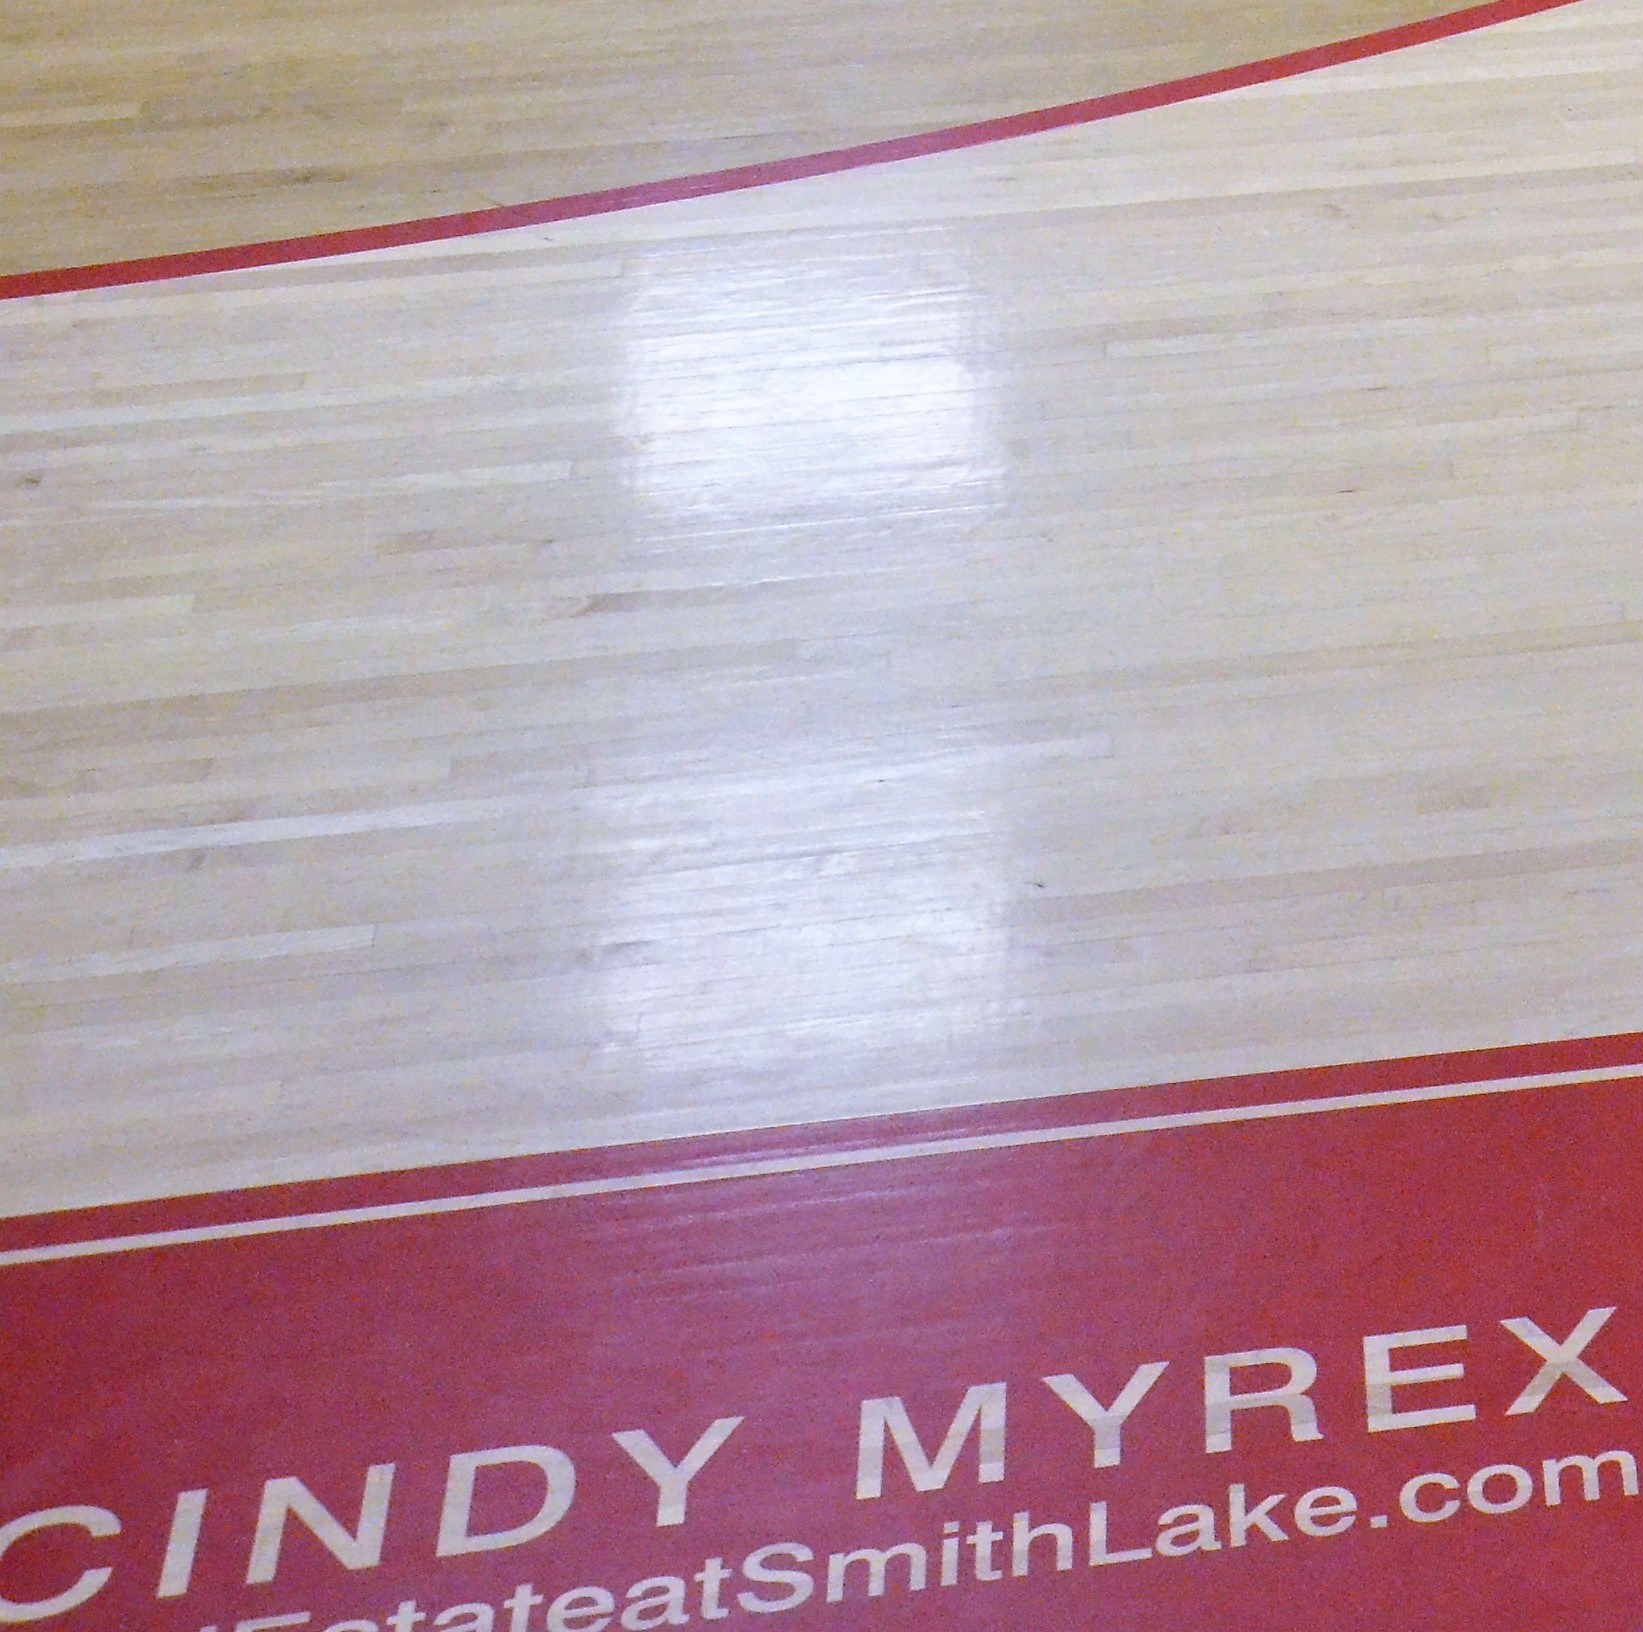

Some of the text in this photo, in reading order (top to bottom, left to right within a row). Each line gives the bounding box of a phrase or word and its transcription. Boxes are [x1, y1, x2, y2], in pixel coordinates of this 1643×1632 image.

[0, 1306, 1629, 1624] CINDY MYREX
[198, 1449, 1640, 1632] tateatSmithLake.com
